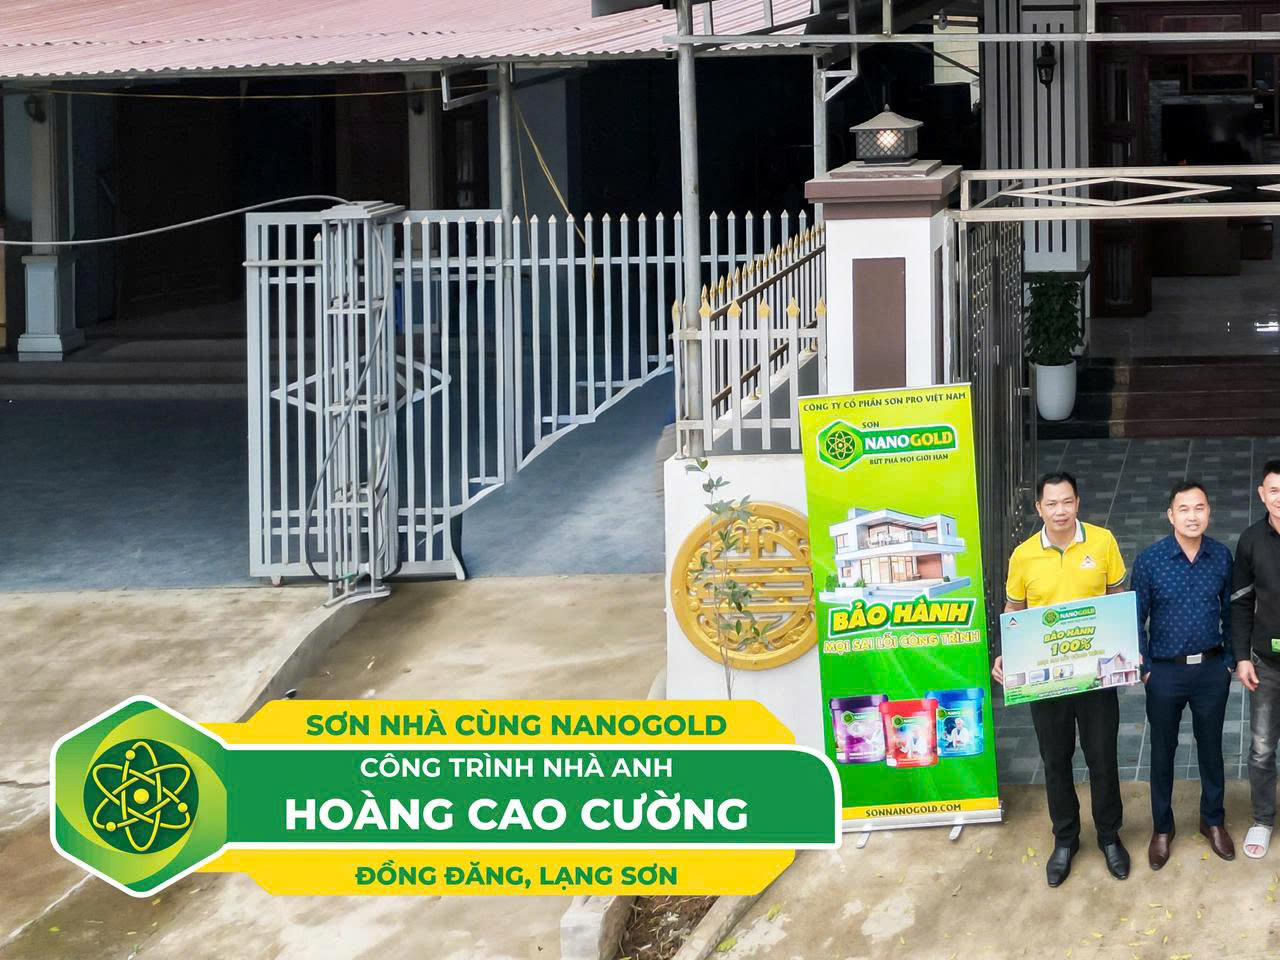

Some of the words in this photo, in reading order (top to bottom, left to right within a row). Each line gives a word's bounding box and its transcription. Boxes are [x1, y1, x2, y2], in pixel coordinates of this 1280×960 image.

[832, 402, 842, 410] TY
[906, 396, 923, 404] PRO
[946, 392, 966, 400] NAM
[864, 431, 953, 450] NANOGOLD
[832, 602, 888, 632] BẢO
[893, 599, 970, 624] HÀNH
[824, 640, 850, 654] MỌI
[852, 638, 873, 652] SAI
[876, 632, 898, 649] LỖI
[900, 632, 938, 648] CÔNG
[940, 630, 980, 644] TRÌNH
[1051, 638, 1094, 656] 100%
[865, 804, 962, 817] SONNANOGOLD.COM
